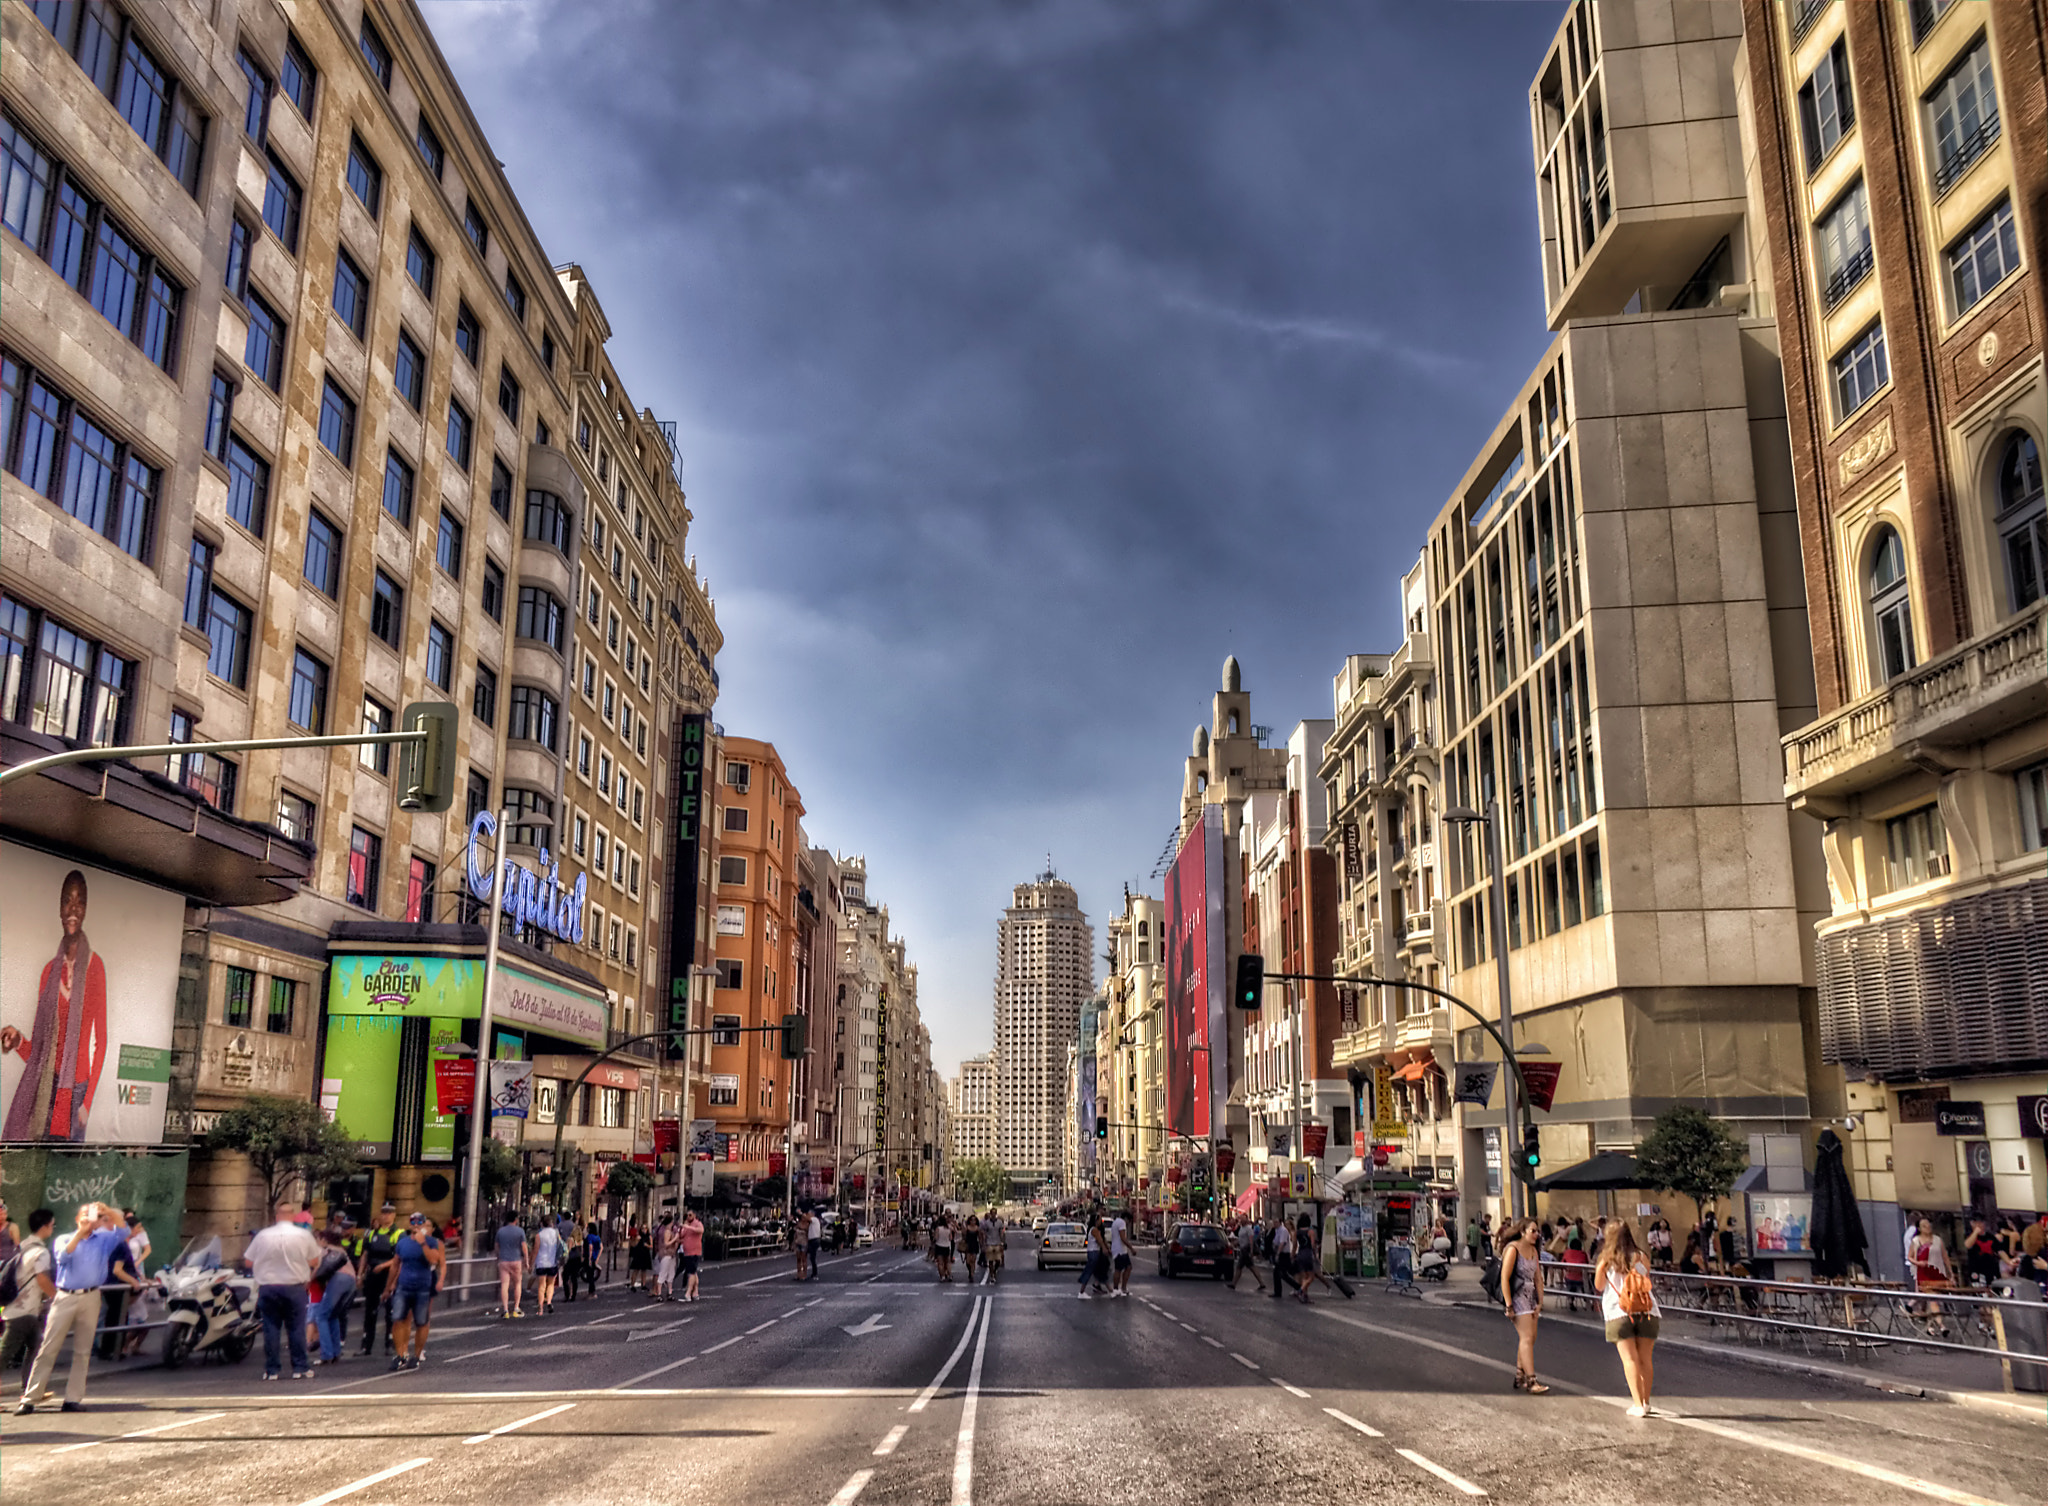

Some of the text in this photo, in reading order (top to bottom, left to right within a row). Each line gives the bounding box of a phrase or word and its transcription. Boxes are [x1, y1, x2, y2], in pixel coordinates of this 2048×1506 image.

[1348, 825, 1357, 864] LAURIA
[466, 809, 588, 944] Capitol
[669, 723, 700, 1050] HOTEL REX
[379, 960, 409, 976] Cine
[363, 975, 421, 993] GARDEN
[605, 1069, 624, 1084] VIPS
[875, 991, 887, 1150] HOTEL EMPERADOR
[1374, 1122, 1406, 1130] Soledad
[1376, 1130, 1405, 1138] Cabello
[1438, 1168, 1453, 1179] GEOX
